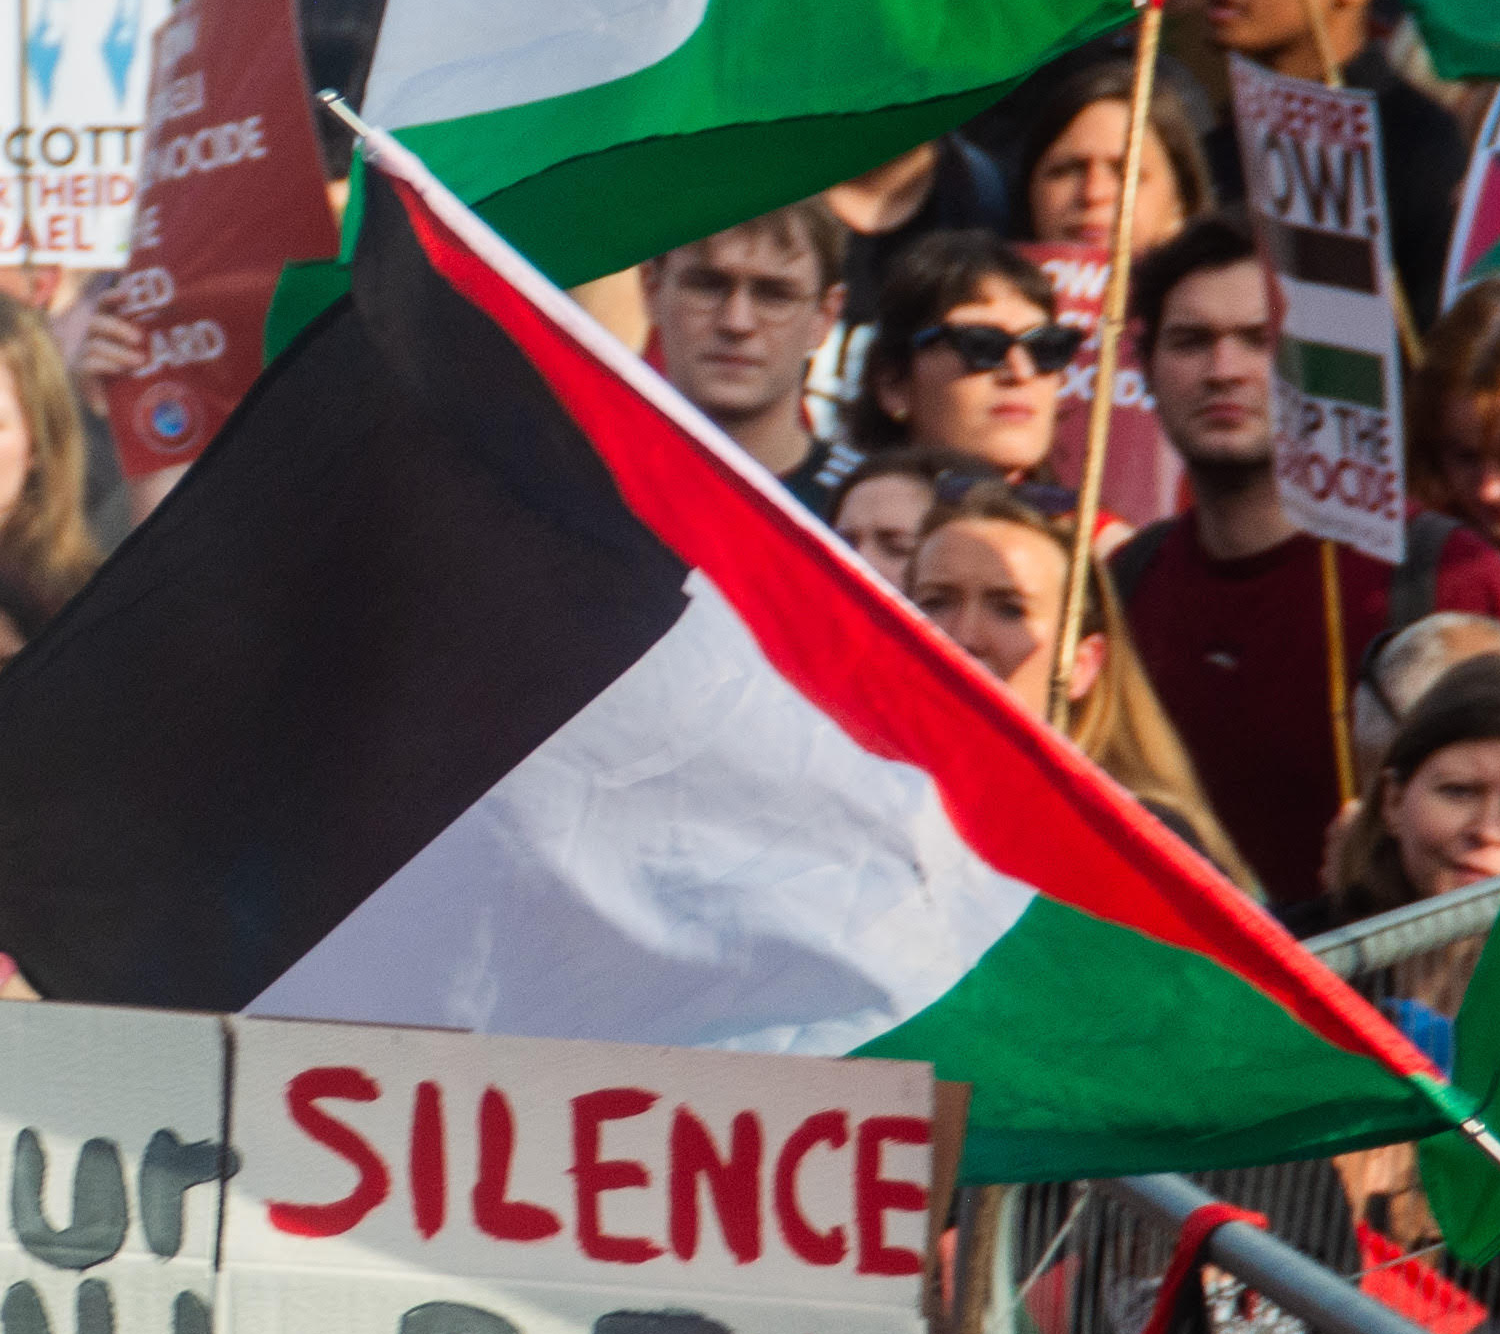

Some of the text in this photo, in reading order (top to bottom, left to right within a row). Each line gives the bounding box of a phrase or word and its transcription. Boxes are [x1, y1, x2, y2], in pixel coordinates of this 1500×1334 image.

[138, 116, 266, 191] NOCIDE
[1263, 133, 1381, 237] OW!
[266, 1065, 933, 1277] SILENCE
